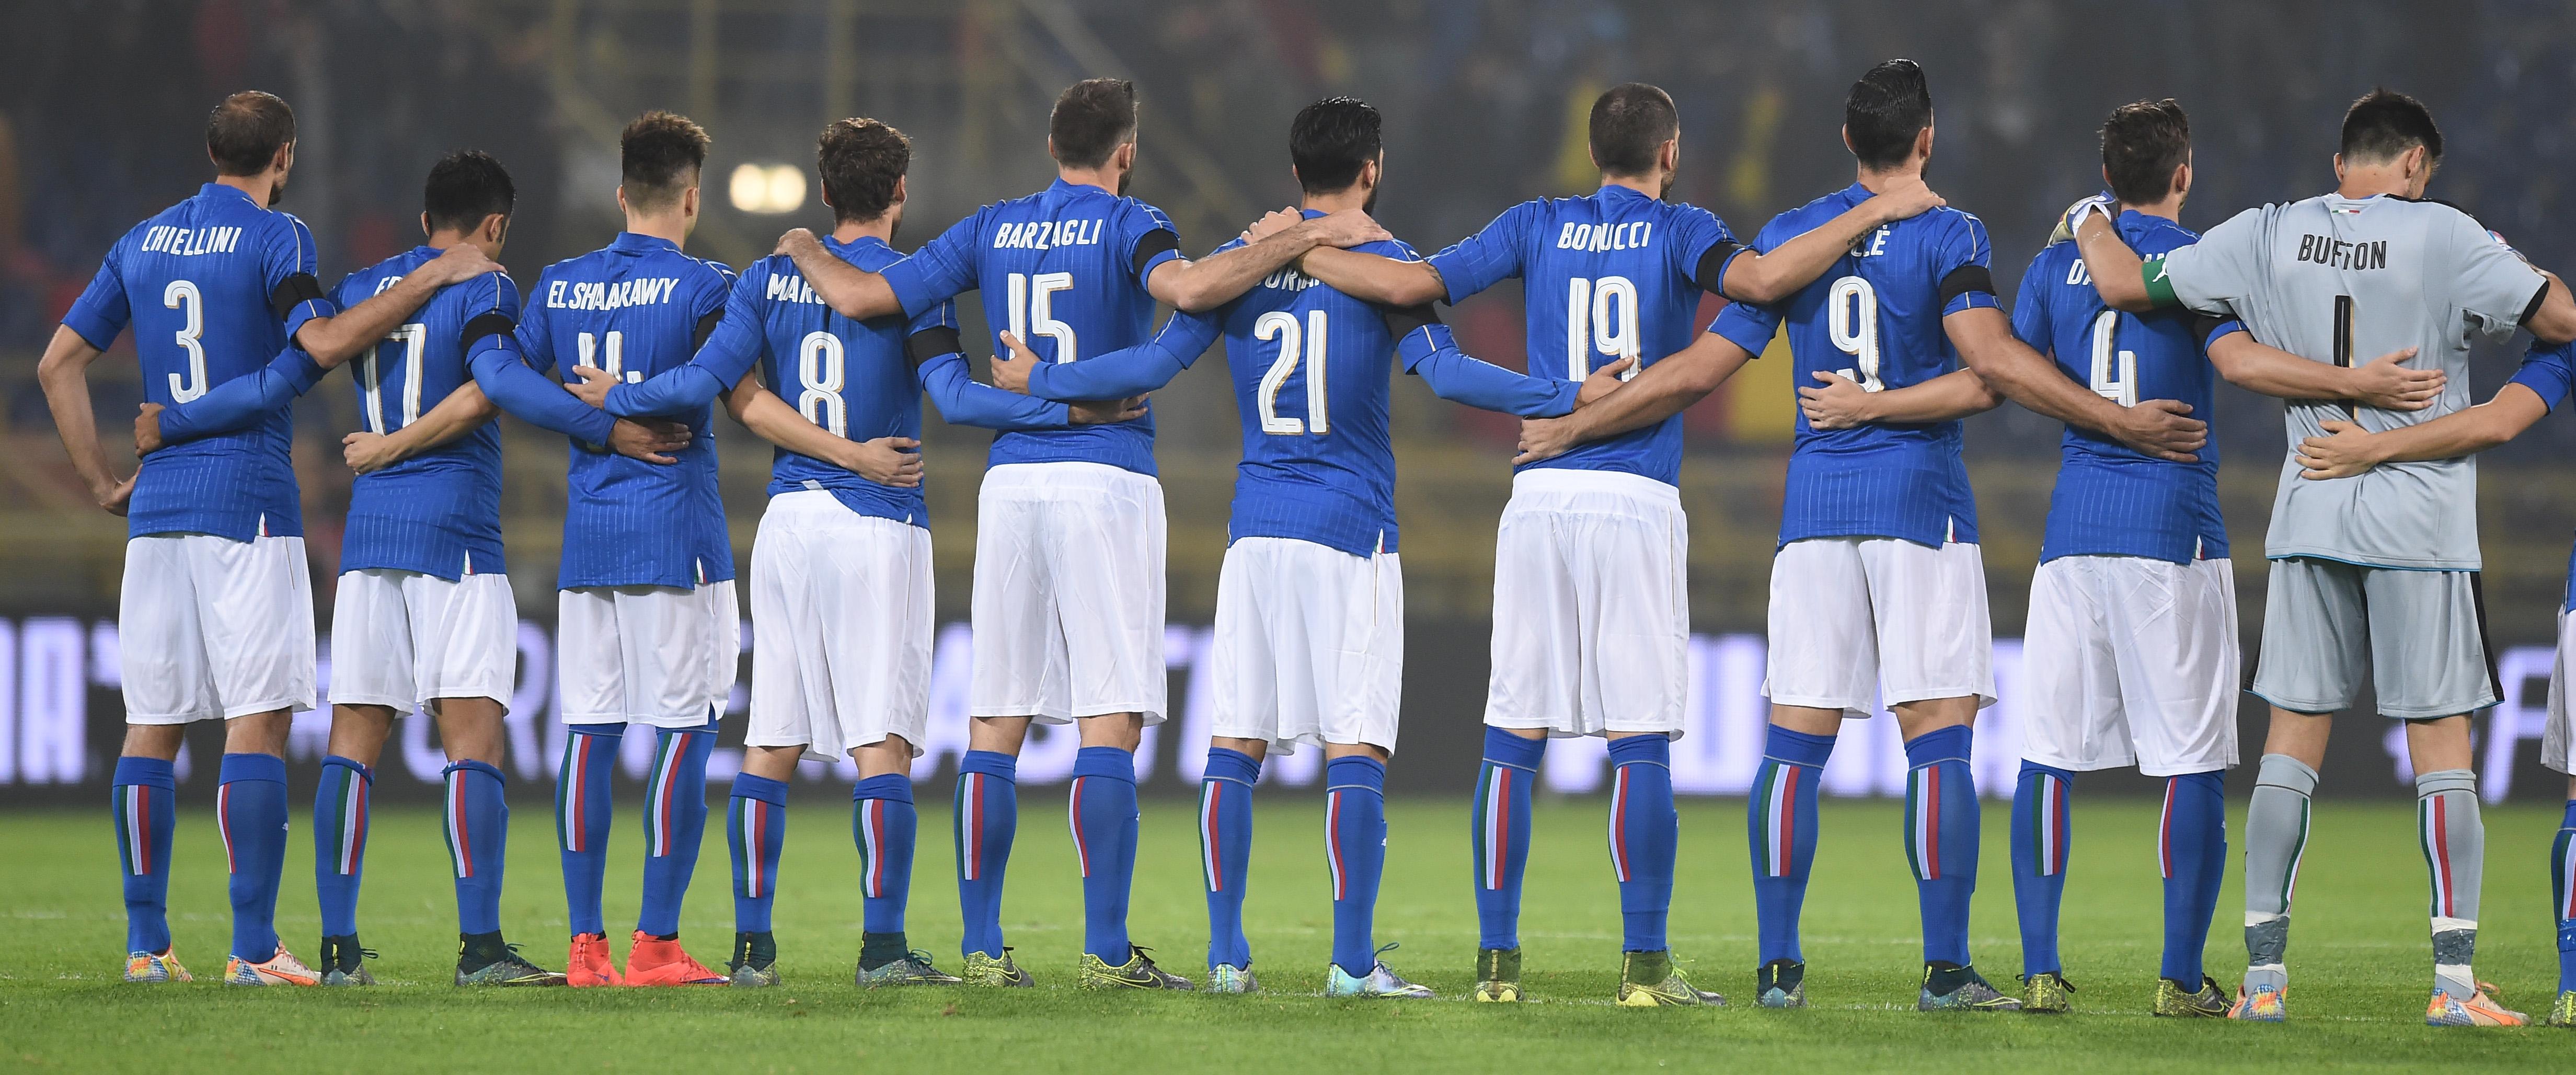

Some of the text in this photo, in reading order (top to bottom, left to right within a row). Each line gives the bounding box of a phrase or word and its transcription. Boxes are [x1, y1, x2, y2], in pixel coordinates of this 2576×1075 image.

[142, 226, 242, 256] CHIELLINI
[994, 219, 1103, 250] BARZAGLI
[164, 280, 208, 404] 3
[1008, 272, 1077, 364] 15
[1568, 276, 1641, 383] 19
[1829, 276, 1885, 393] 9
[2090, 311, 2140, 408] 4
[799, 330, 848, 439] 8
[1255, 310, 1330, 435] 21
